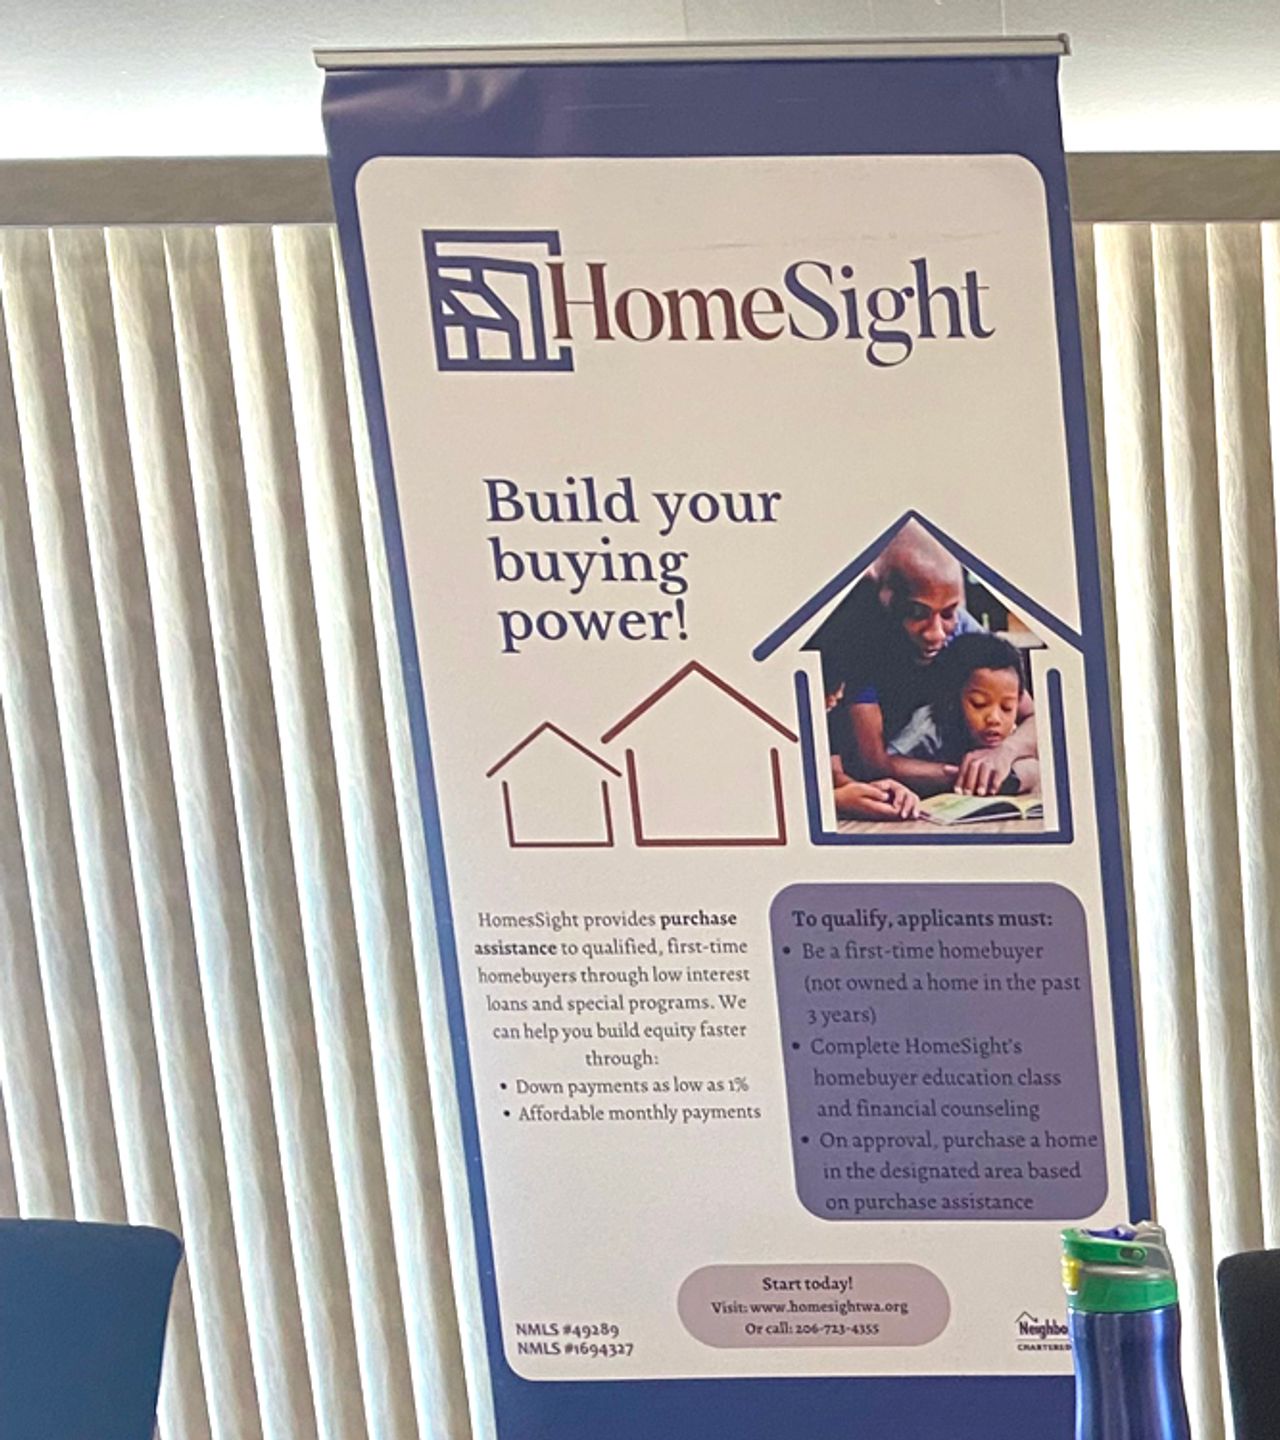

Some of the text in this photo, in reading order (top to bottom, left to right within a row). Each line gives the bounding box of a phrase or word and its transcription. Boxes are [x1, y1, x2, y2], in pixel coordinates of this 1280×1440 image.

[546, 257, 996, 368] HomeSight
[484, 477, 782, 534] Build your
[491, 538, 688, 594] buying
[500, 599, 688, 654] power!
[584, 911, 655, 930] provides
[661, 910, 737, 930] purchase
[792, 910, 1052, 931] To qualify, applicants must:
[474, 938, 748, 958] assistance to qualified, first-time
[803, 941, 1043, 962] Be a first-time homebuyer
[478, 966, 750, 987] homebuyers through low interest
[805, 973, 1080, 994] (not owned a home in the past
[487, 994, 746, 1014] loans and special programs. We
[808, 1007, 876, 1027] 3 years)
[493, 1020, 746, 1042] can help you build equity faster
[810, 1037, 1022, 1058] Complete HomeSight's
[586, 1050, 659, 1069] through:
[516, 1076, 750, 1097] Down payments as low as 1%
[814, 1069, 1062, 1090] homebuyer education class
[519, 1104, 761, 1124] Affordable monthly payments
[818, 1100, 1040, 1121] and financial counseling
[820, 1131, 1098, 1152] On approval, purchase a home
[823, 1162, 1081, 1183] in the designated area based
[826, 1194, 1033, 1214] on purchase assistance
[763, 1276, 853, 1292] Start today!
[712, 1299, 908, 1315] Visit: www.homesightwa.org
[516, 1323, 619, 1339] NMLS #49289
[746, 1322, 879, 1335] Or call: 206-723-4355
[1020, 1319, 1068, 1339] Neighbo
[517, 1342, 634, 1358] NMLS #1694327
